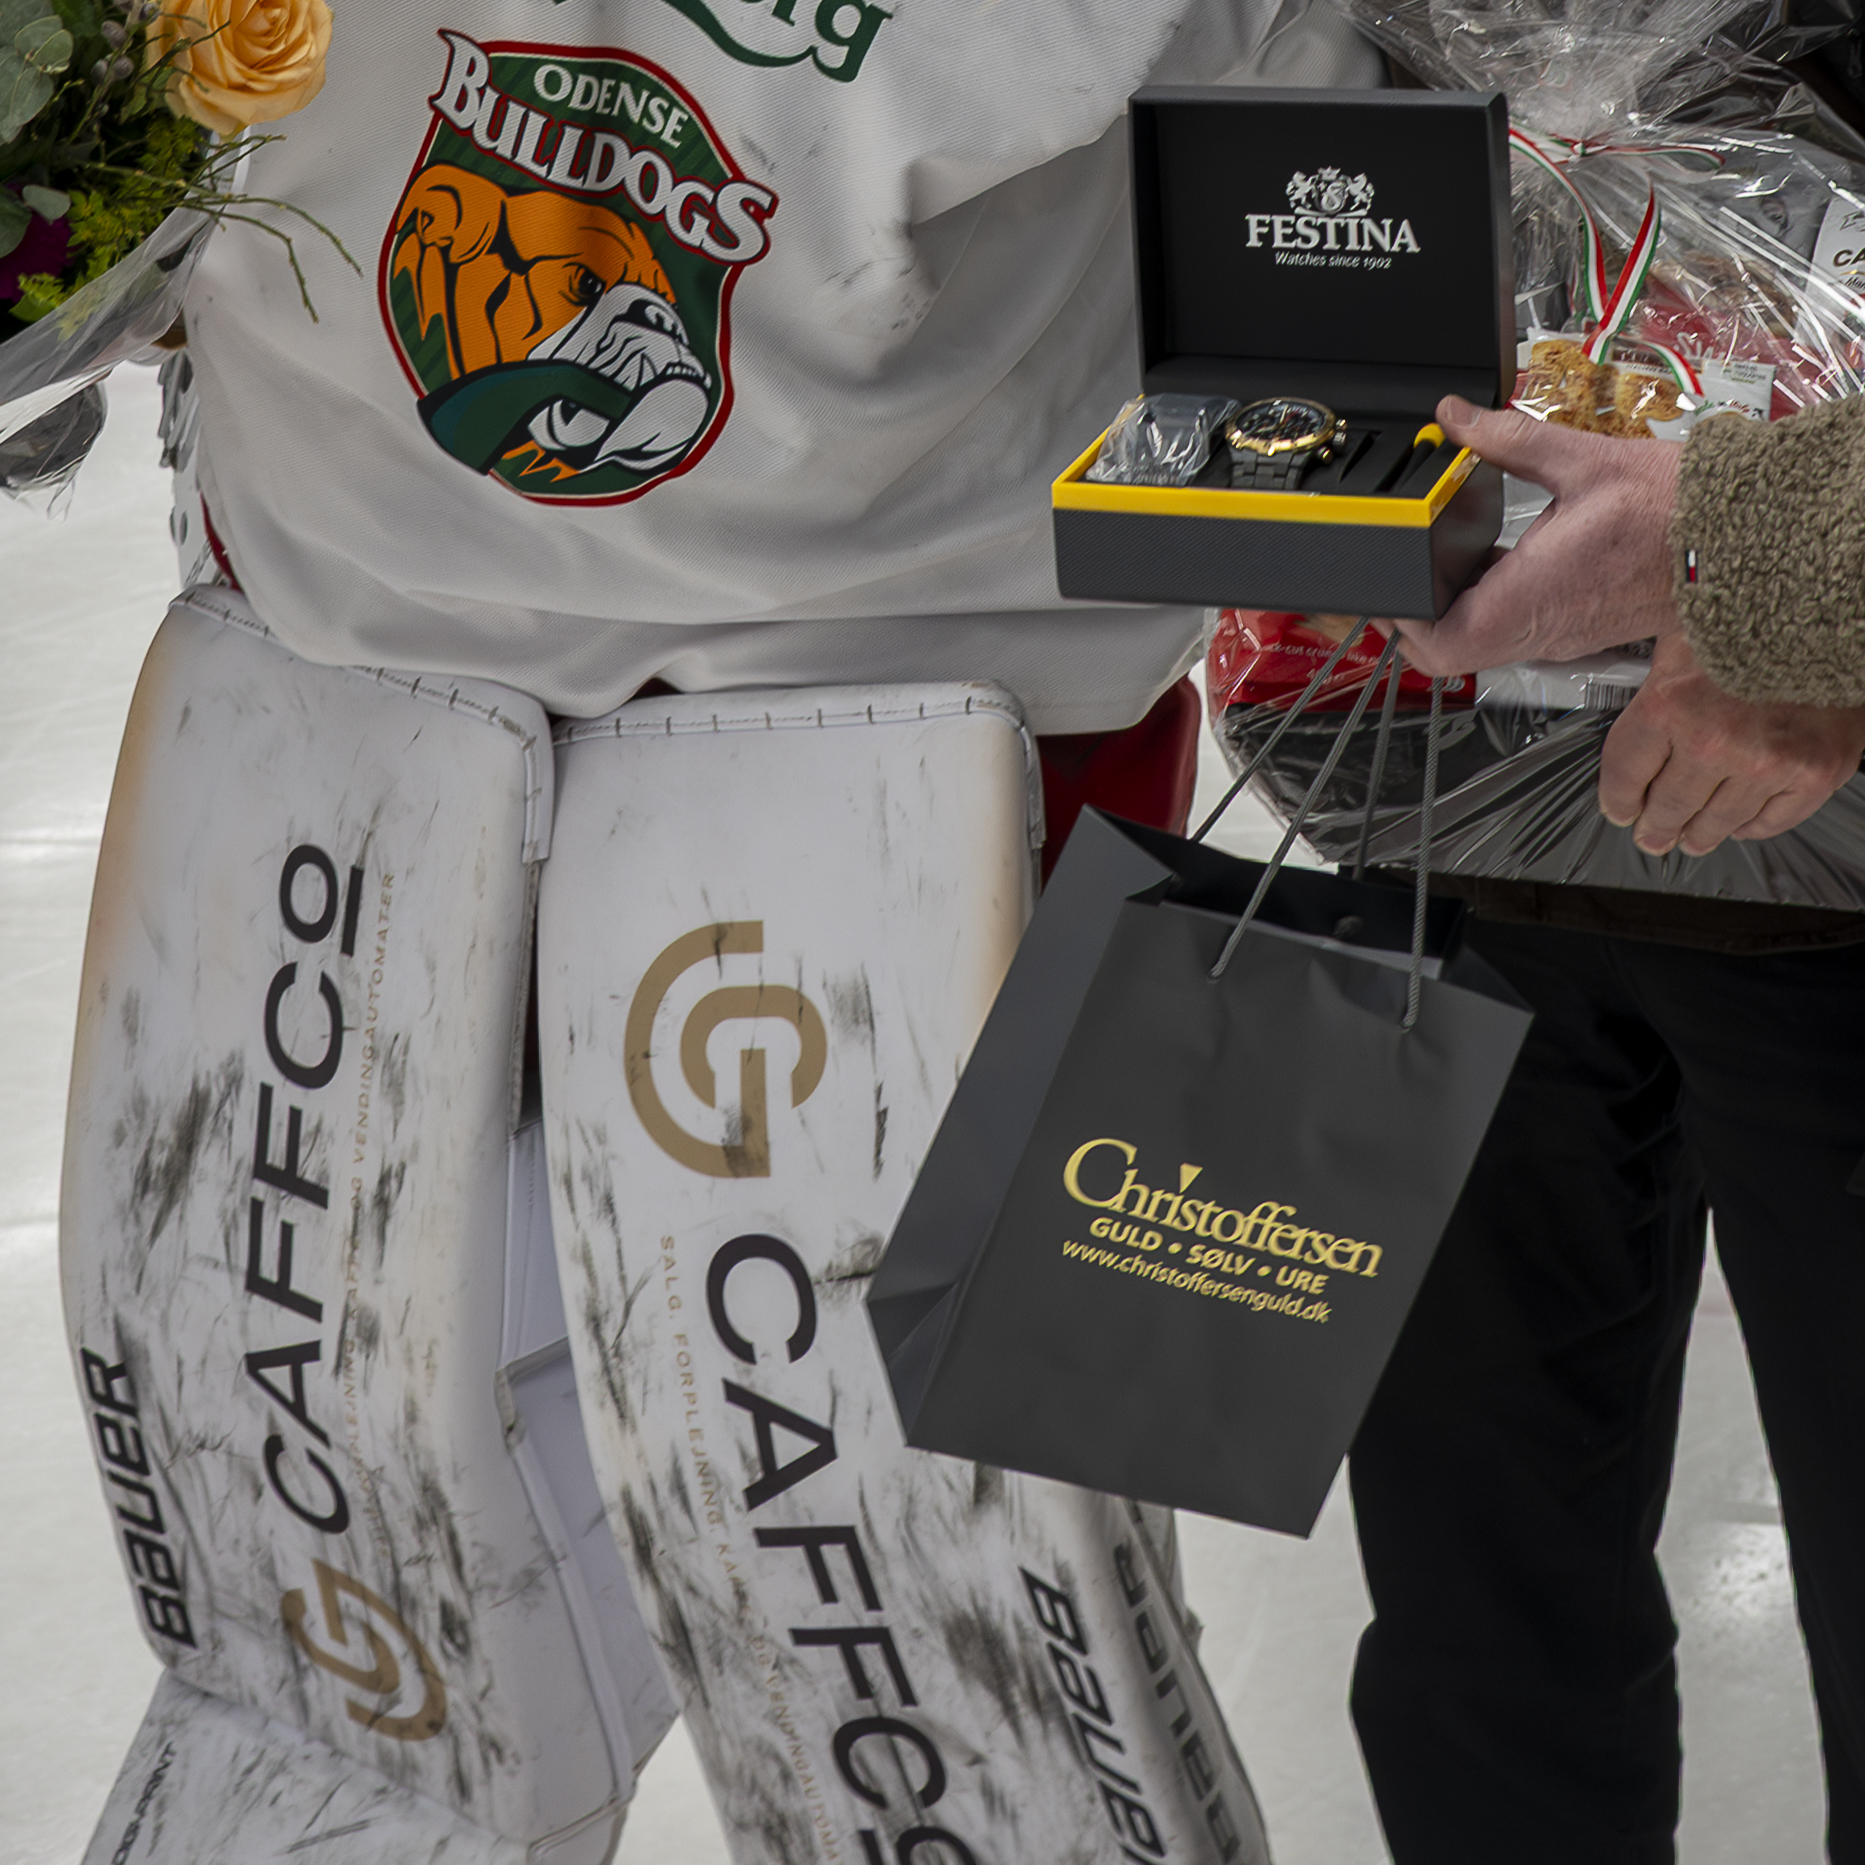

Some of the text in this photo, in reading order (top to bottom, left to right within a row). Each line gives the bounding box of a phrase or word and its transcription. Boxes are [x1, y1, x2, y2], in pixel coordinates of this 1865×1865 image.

[430, 29, 779, 266] BULLDOGS
[533, 61, 691, 150] ODENSE
[1244, 213, 1422, 254] FESTINA
[1274, 251, 1393, 271] Watches since 1902
[1063, 1138, 1383, 1277] Christoffersen
[1062, 1239, 1333, 1323] www.christoffersenguld.dk
[1089, 1216, 1330, 1295] GULD SØLV URE
